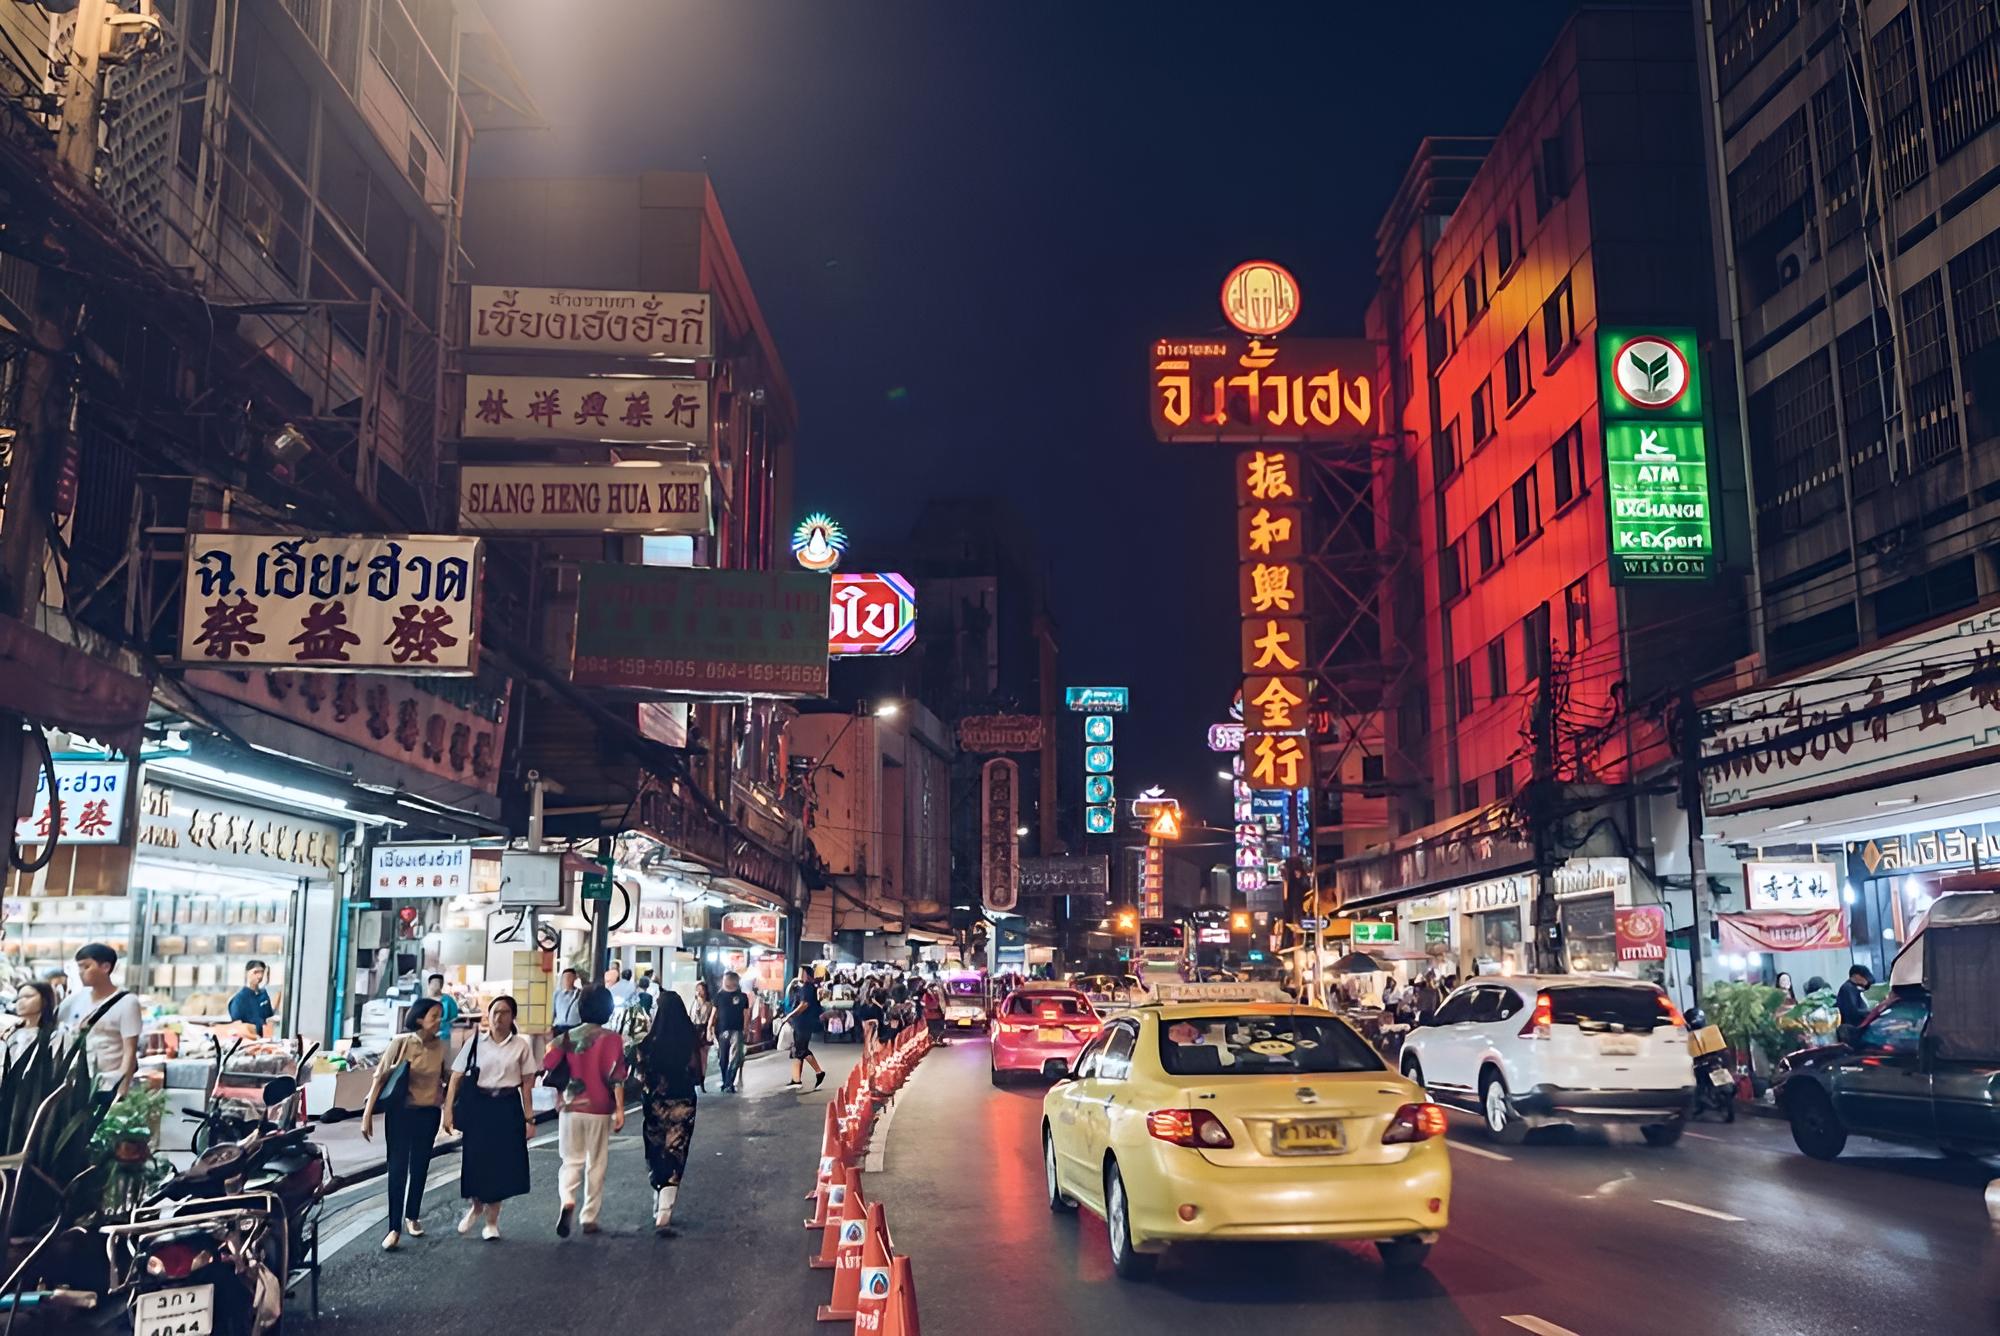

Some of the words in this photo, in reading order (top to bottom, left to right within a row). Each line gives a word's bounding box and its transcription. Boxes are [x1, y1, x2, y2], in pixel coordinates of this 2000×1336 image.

[1637, 466, 1680, 483] ATM
[468, 482, 535, 515] SIANG
[541, 482, 601, 515] HENG
[607, 482, 651, 515] HUA
[658, 482, 701, 515] KEE
[1624, 561, 1705, 574] WISDOM
